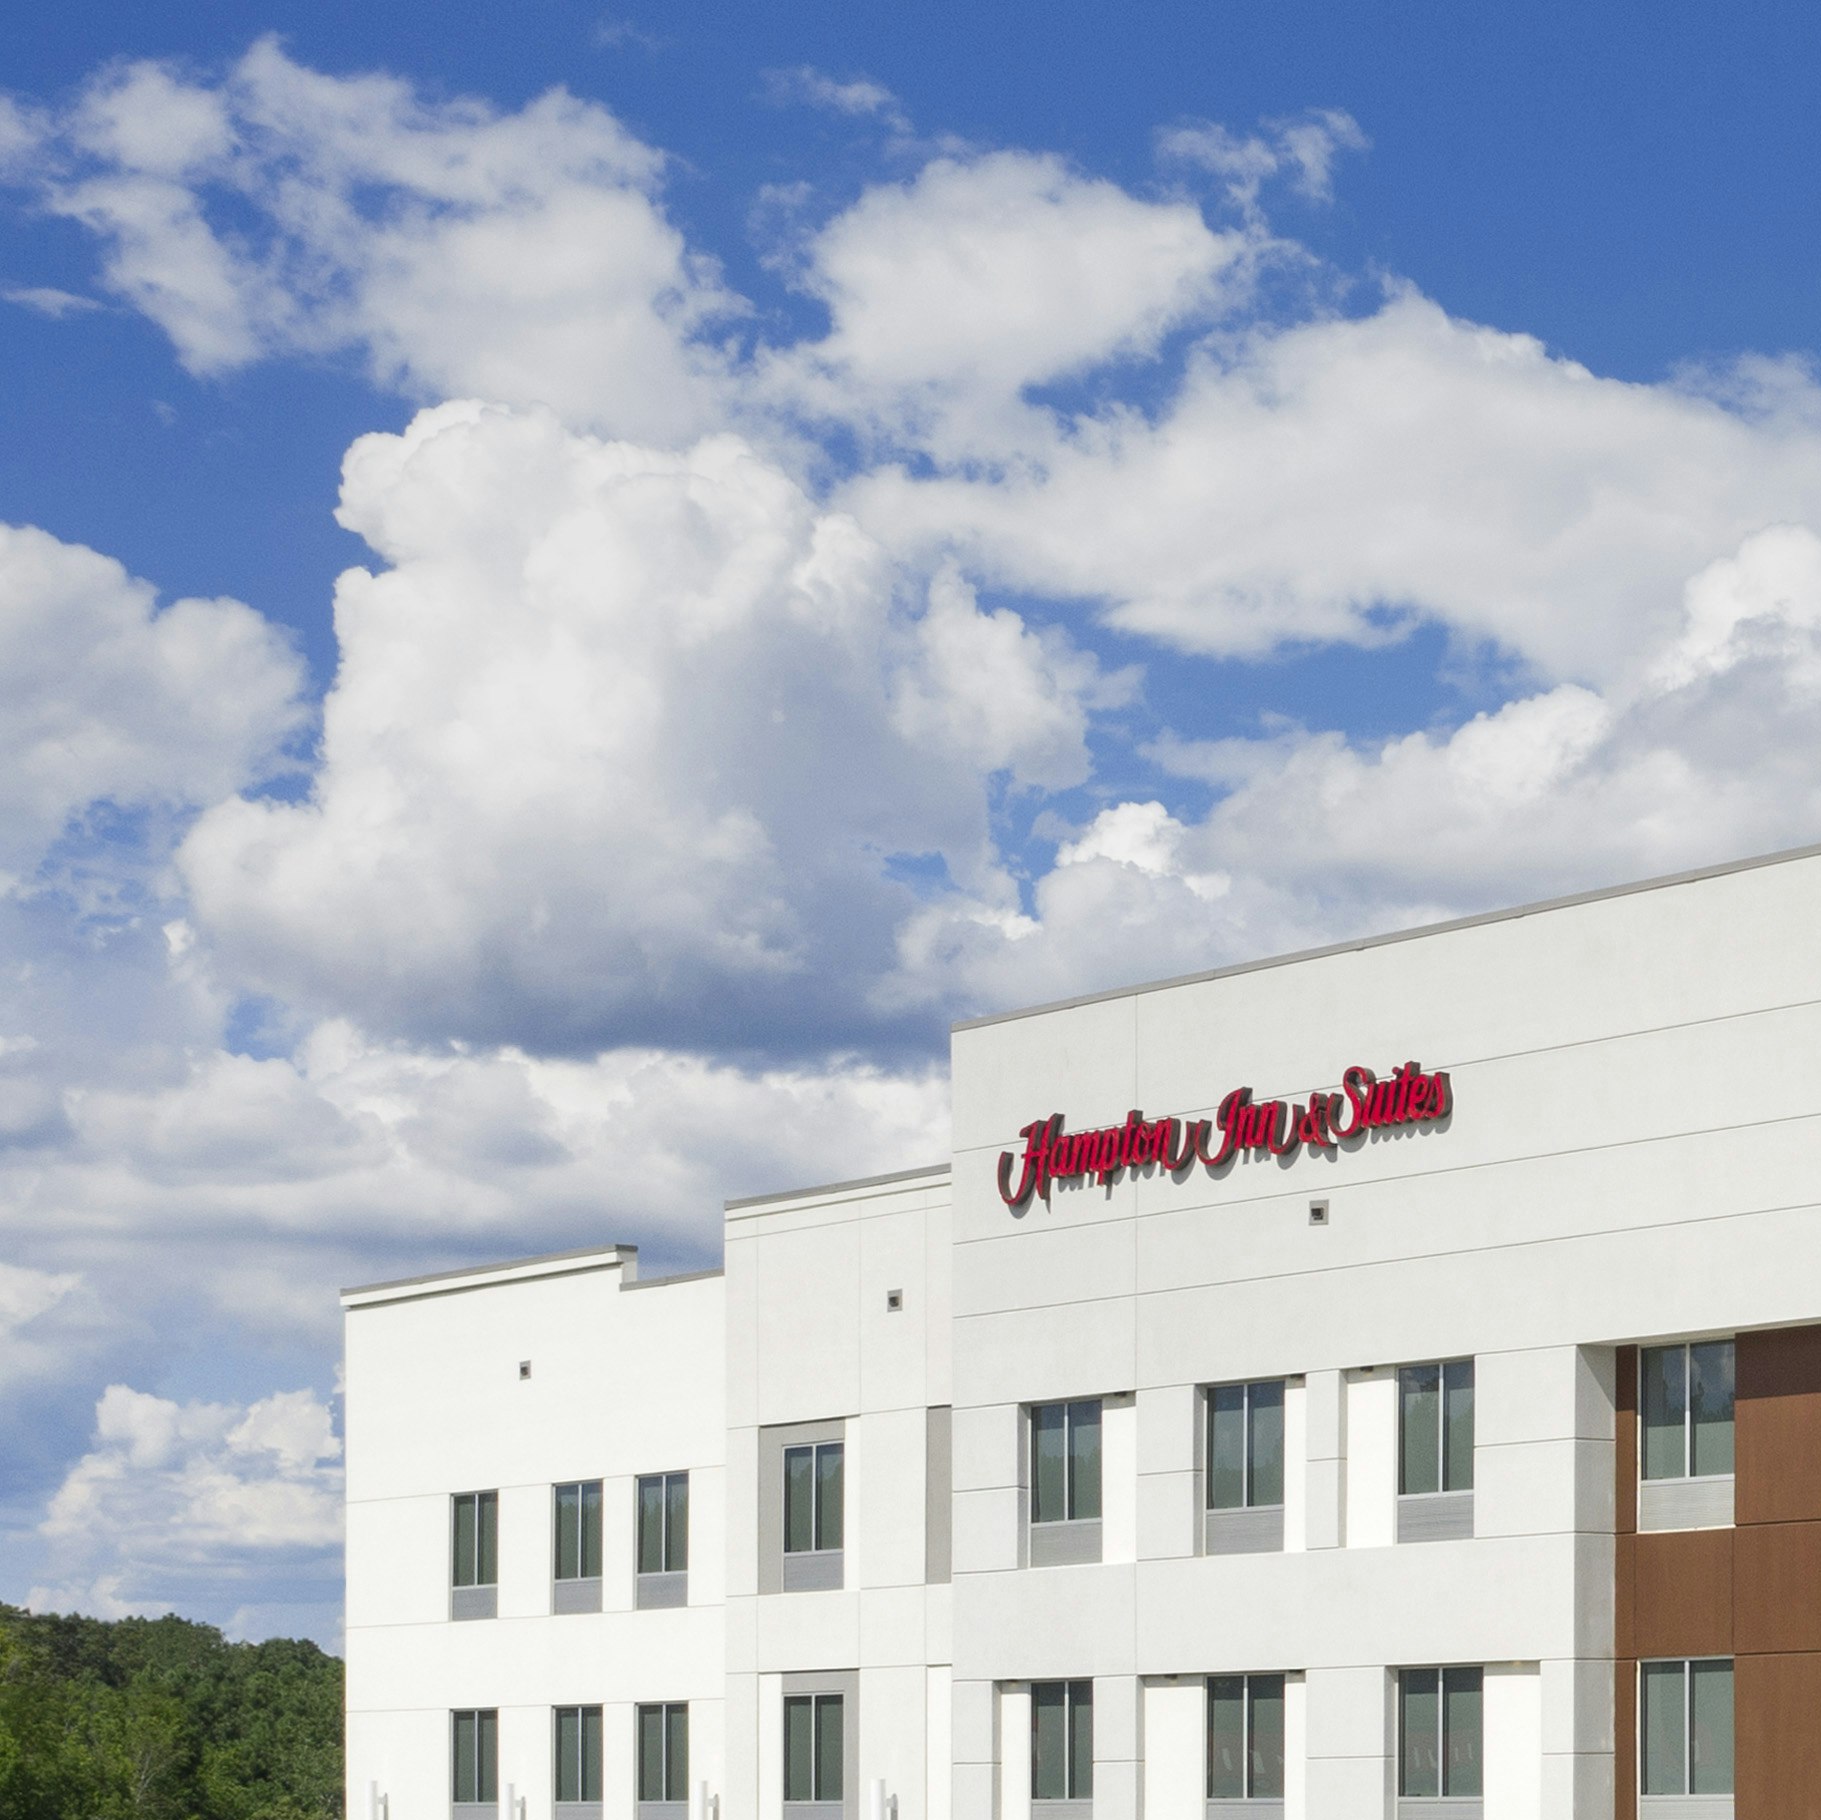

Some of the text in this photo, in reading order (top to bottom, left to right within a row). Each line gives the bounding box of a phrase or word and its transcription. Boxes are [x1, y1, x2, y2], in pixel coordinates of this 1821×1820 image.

[998, 1061, 1450, 1206] Hampton Inn & Suites
